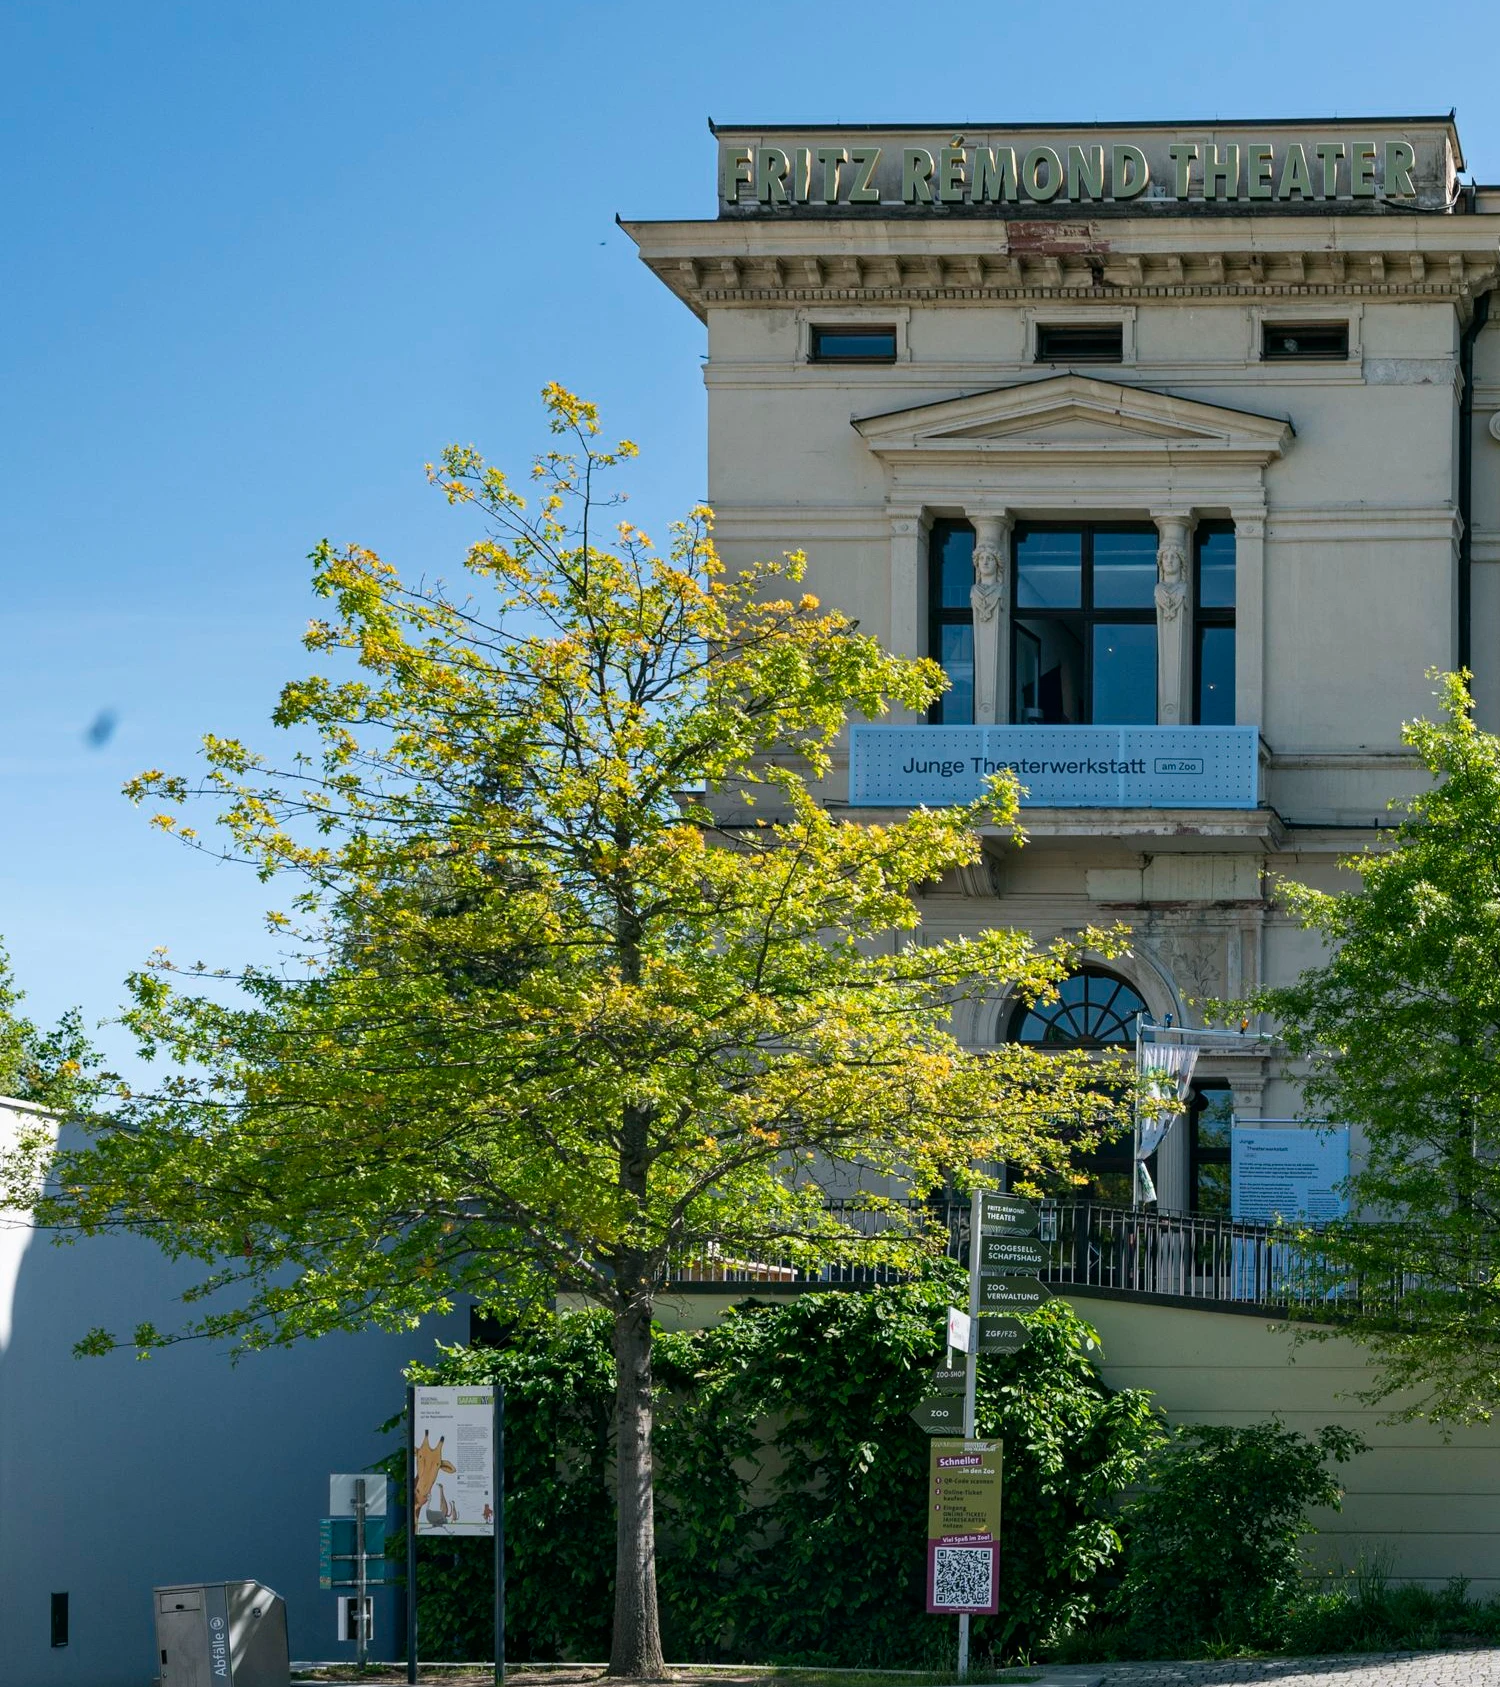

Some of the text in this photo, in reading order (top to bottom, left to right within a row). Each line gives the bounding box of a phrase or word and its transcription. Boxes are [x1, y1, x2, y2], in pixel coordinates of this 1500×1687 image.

[724, 134, 1417, 202] FRITZ RÉMOND THEATER
[903, 757, 1146, 778] Junge Theaterwerkstatt
[1161, 762, 1197, 772] am Zoo
[987, 1212, 1016, 1222] THEATER
[988, 1244, 1037, 1254] ZOOGESELL-
[988, 1252, 1042, 1263] SCHAFTSHAUS
[986, 1292, 1040, 1301] VERWALTUNG
[985, 1330, 1018, 1338] ZGF/FZS
[936, 1370, 966, 1378] ZOO-SHOP
[930, 1409, 949, 1417] ZOO
[940, 1456, 979, 1467] Schneller
[212, 1632, 227, 1677] Abfälle
